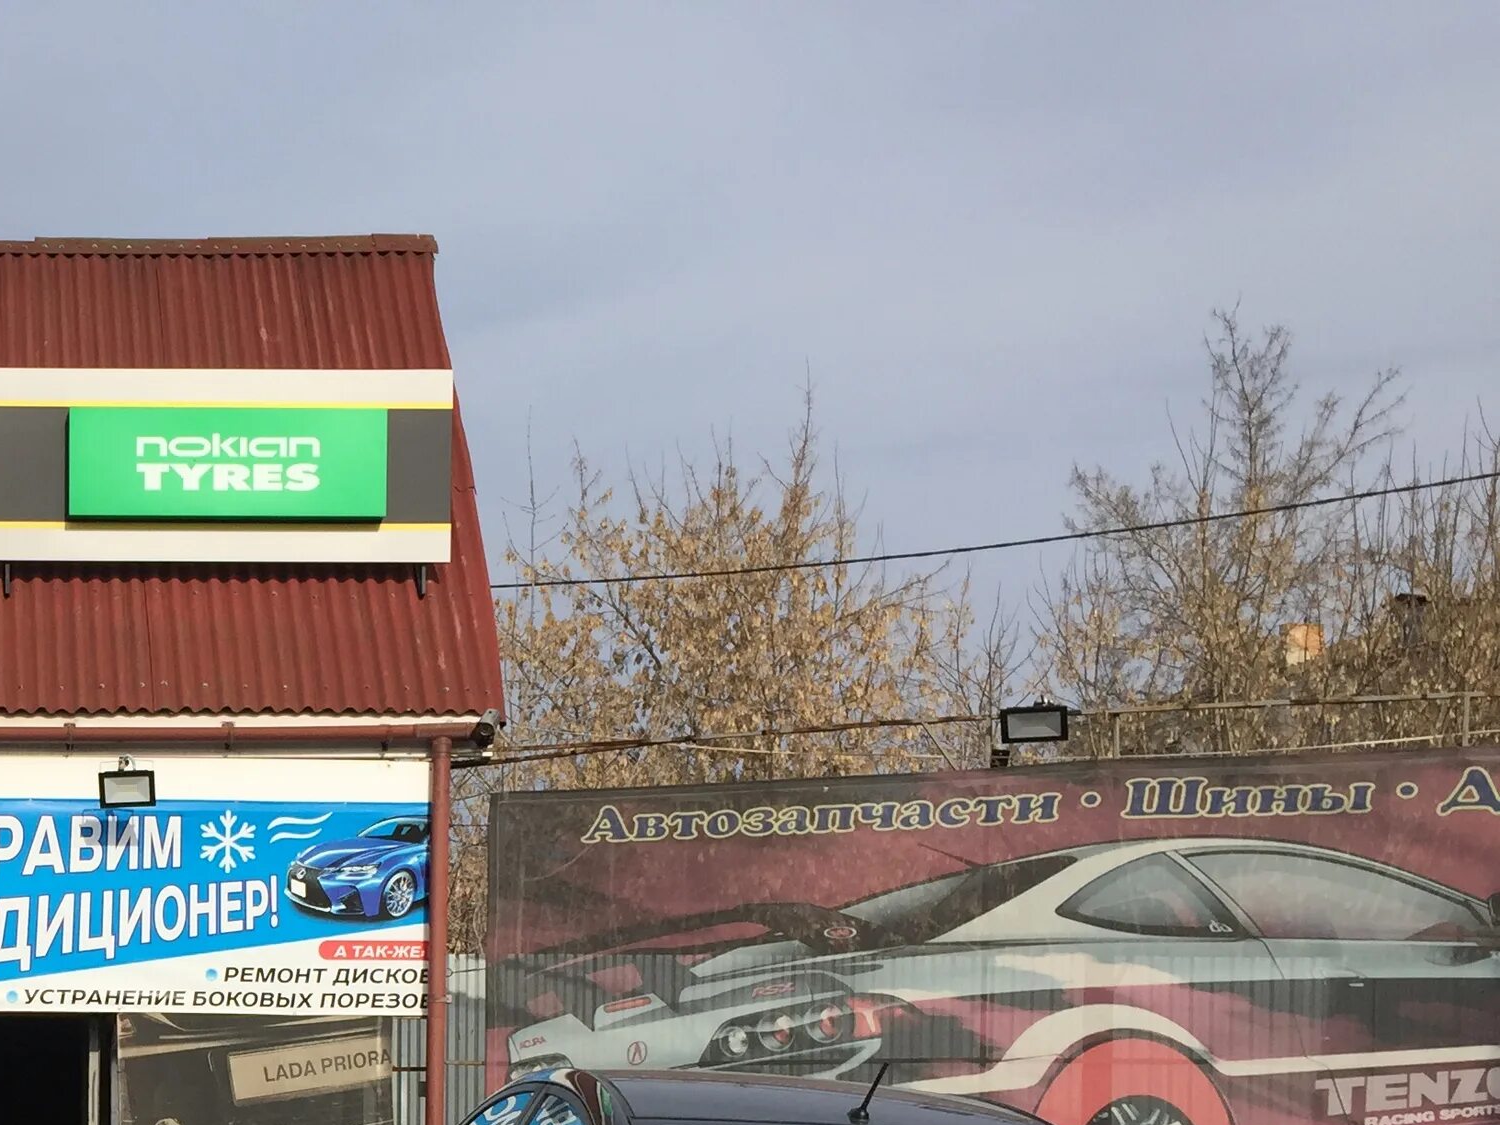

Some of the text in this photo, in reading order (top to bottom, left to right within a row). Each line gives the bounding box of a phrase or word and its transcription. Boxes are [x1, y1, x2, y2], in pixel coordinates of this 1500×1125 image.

[136, 462, 321, 491] TYRES
[581, 792, 1060, 844] Автозапчасти
[1121, 776, 1376, 819] Шины
[333, 946, 347, 959] А
[224, 967, 328, 984] РЕМОНТ
[24, 989, 186, 1007] УСТРАНЕНИЕ
[191, 990, 313, 1009] БОКОВЫХ
[263, 1049, 393, 1083] LADA PRIORA
